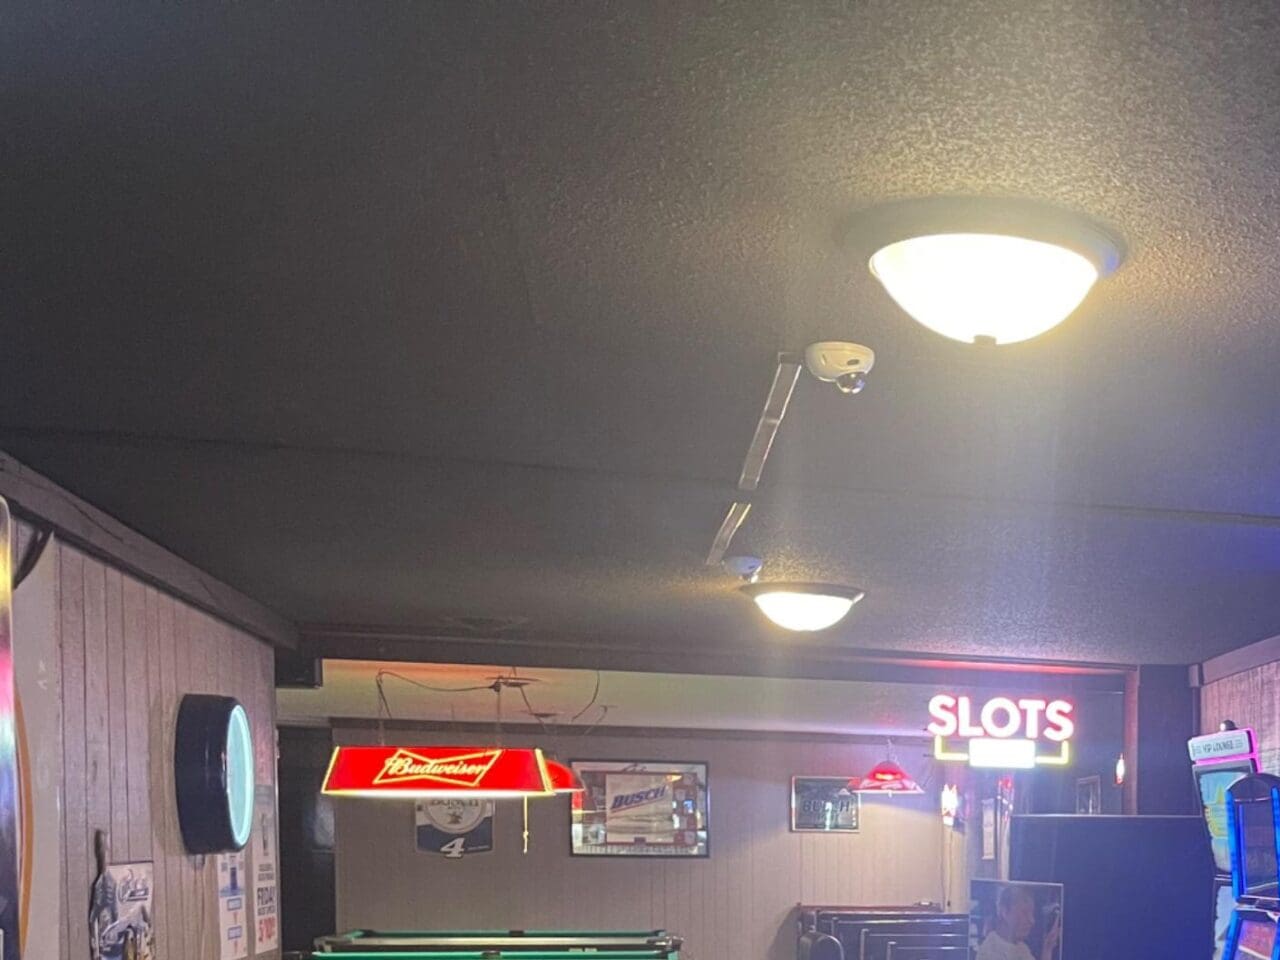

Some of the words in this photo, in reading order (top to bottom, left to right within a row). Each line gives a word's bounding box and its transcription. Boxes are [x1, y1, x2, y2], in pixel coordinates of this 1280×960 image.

[927, 694, 1075, 742] SLOTS
[385, 756, 490, 776] Budweiser
[612, 784, 666, 809] BUSCH
[440, 837, 465, 858] 4
